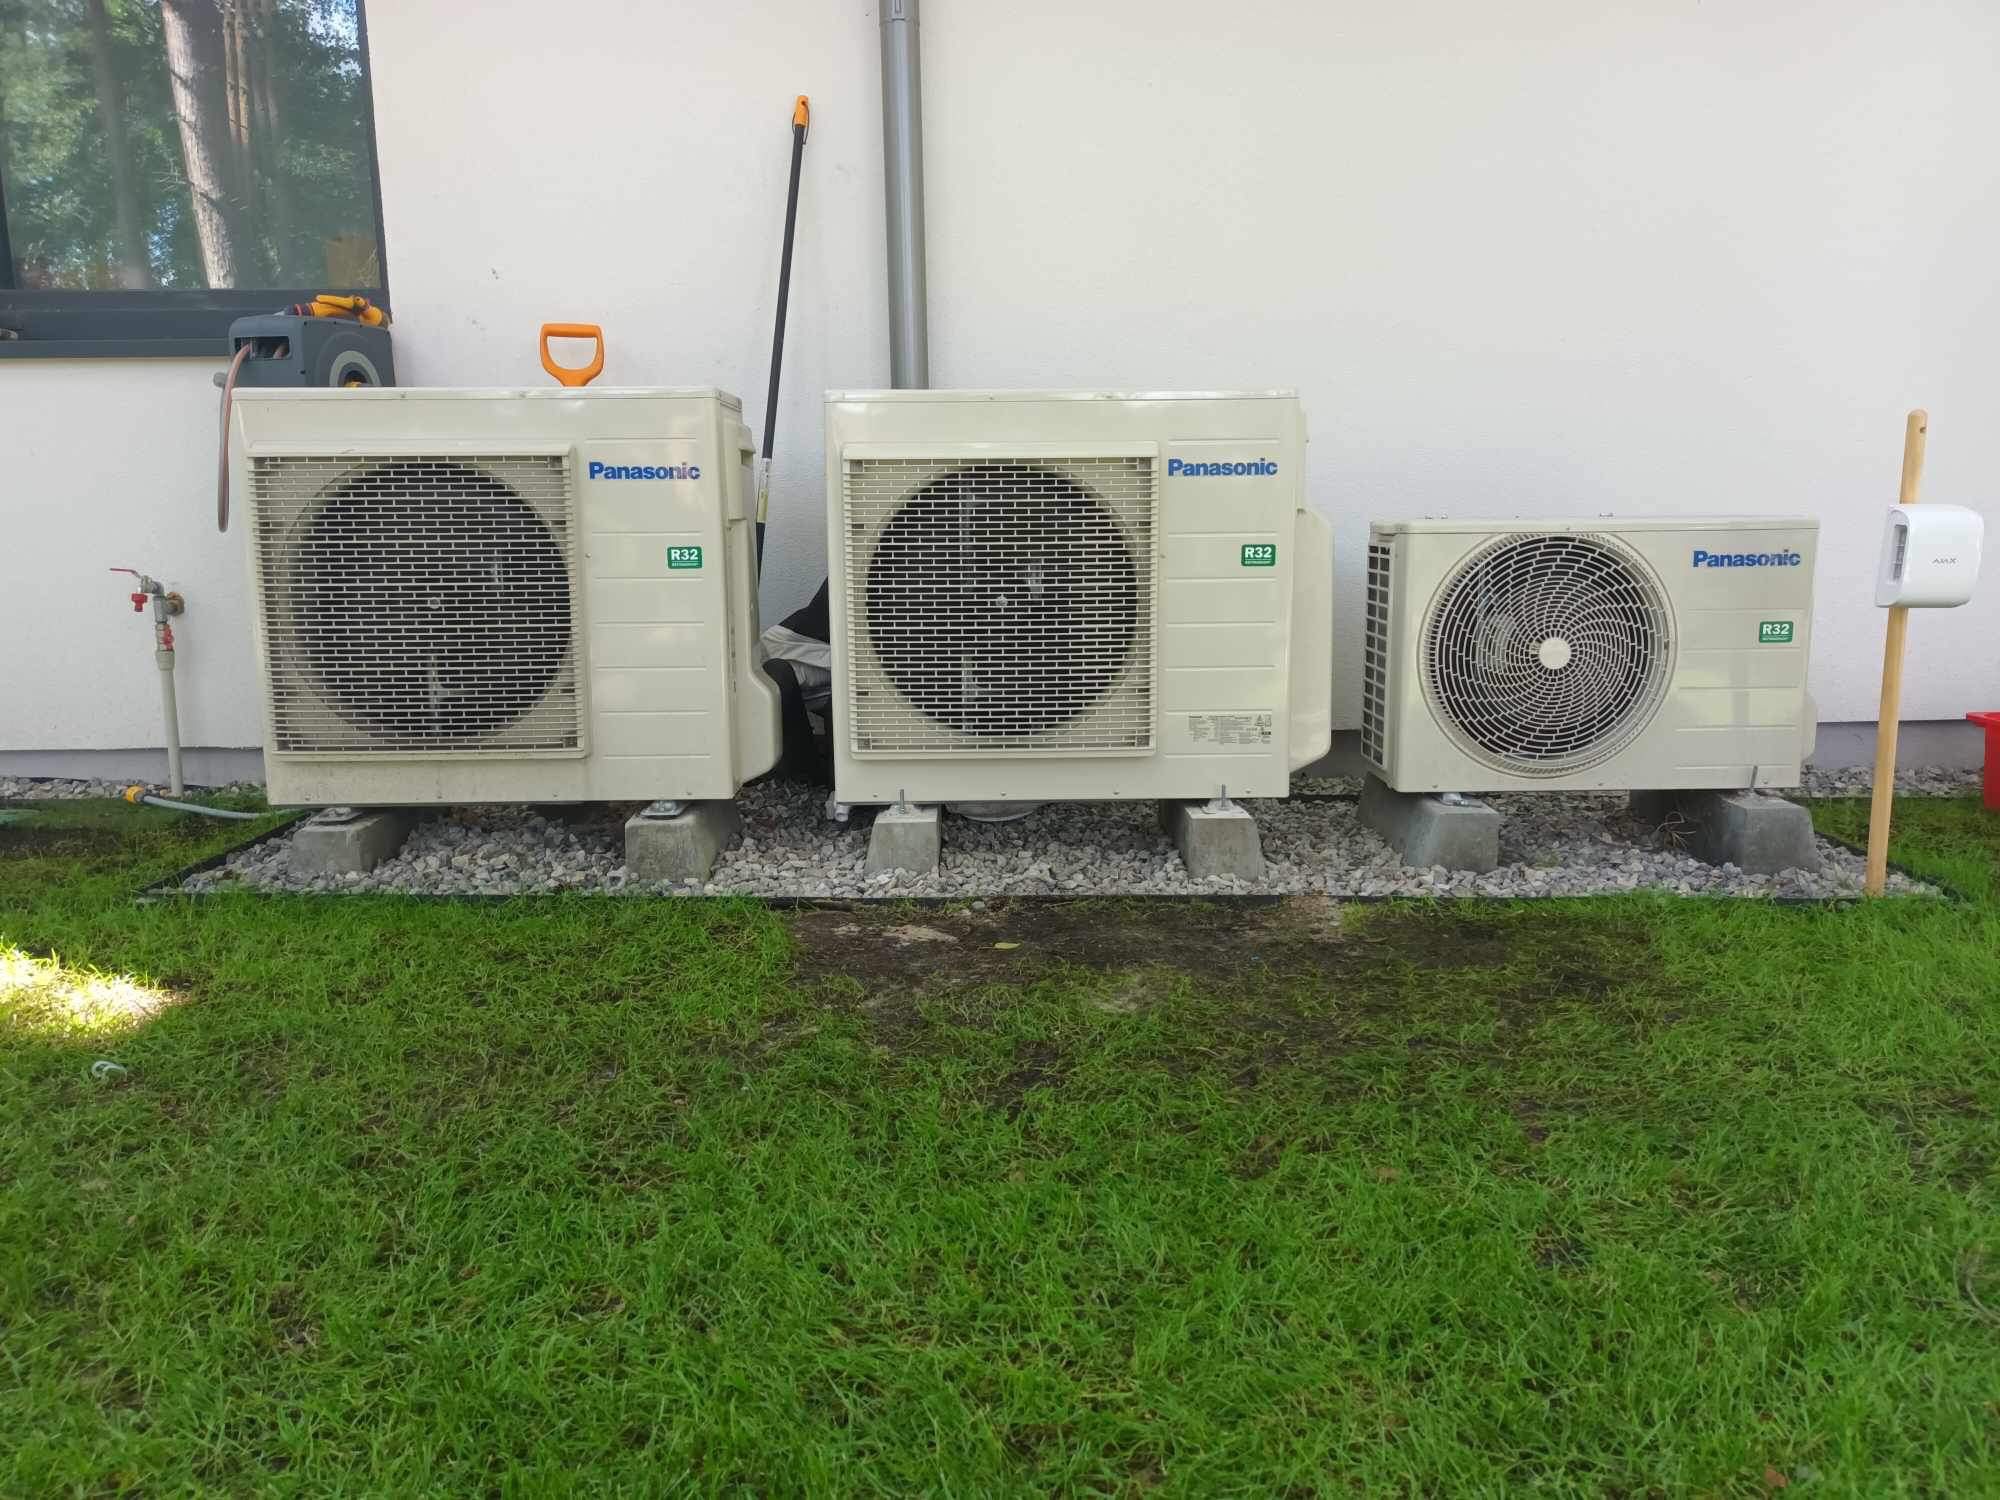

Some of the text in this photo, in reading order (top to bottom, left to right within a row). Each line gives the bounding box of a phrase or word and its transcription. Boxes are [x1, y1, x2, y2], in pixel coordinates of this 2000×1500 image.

[589, 461, 701, 480] Panasonic
[1167, 457, 1278, 477] Panasonic
[670, 548, 699, 561] R32
[1245, 546, 1273, 559] R32
[1692, 548, 1801, 568] Panasonic
[1762, 623, 1790, 635] R32
